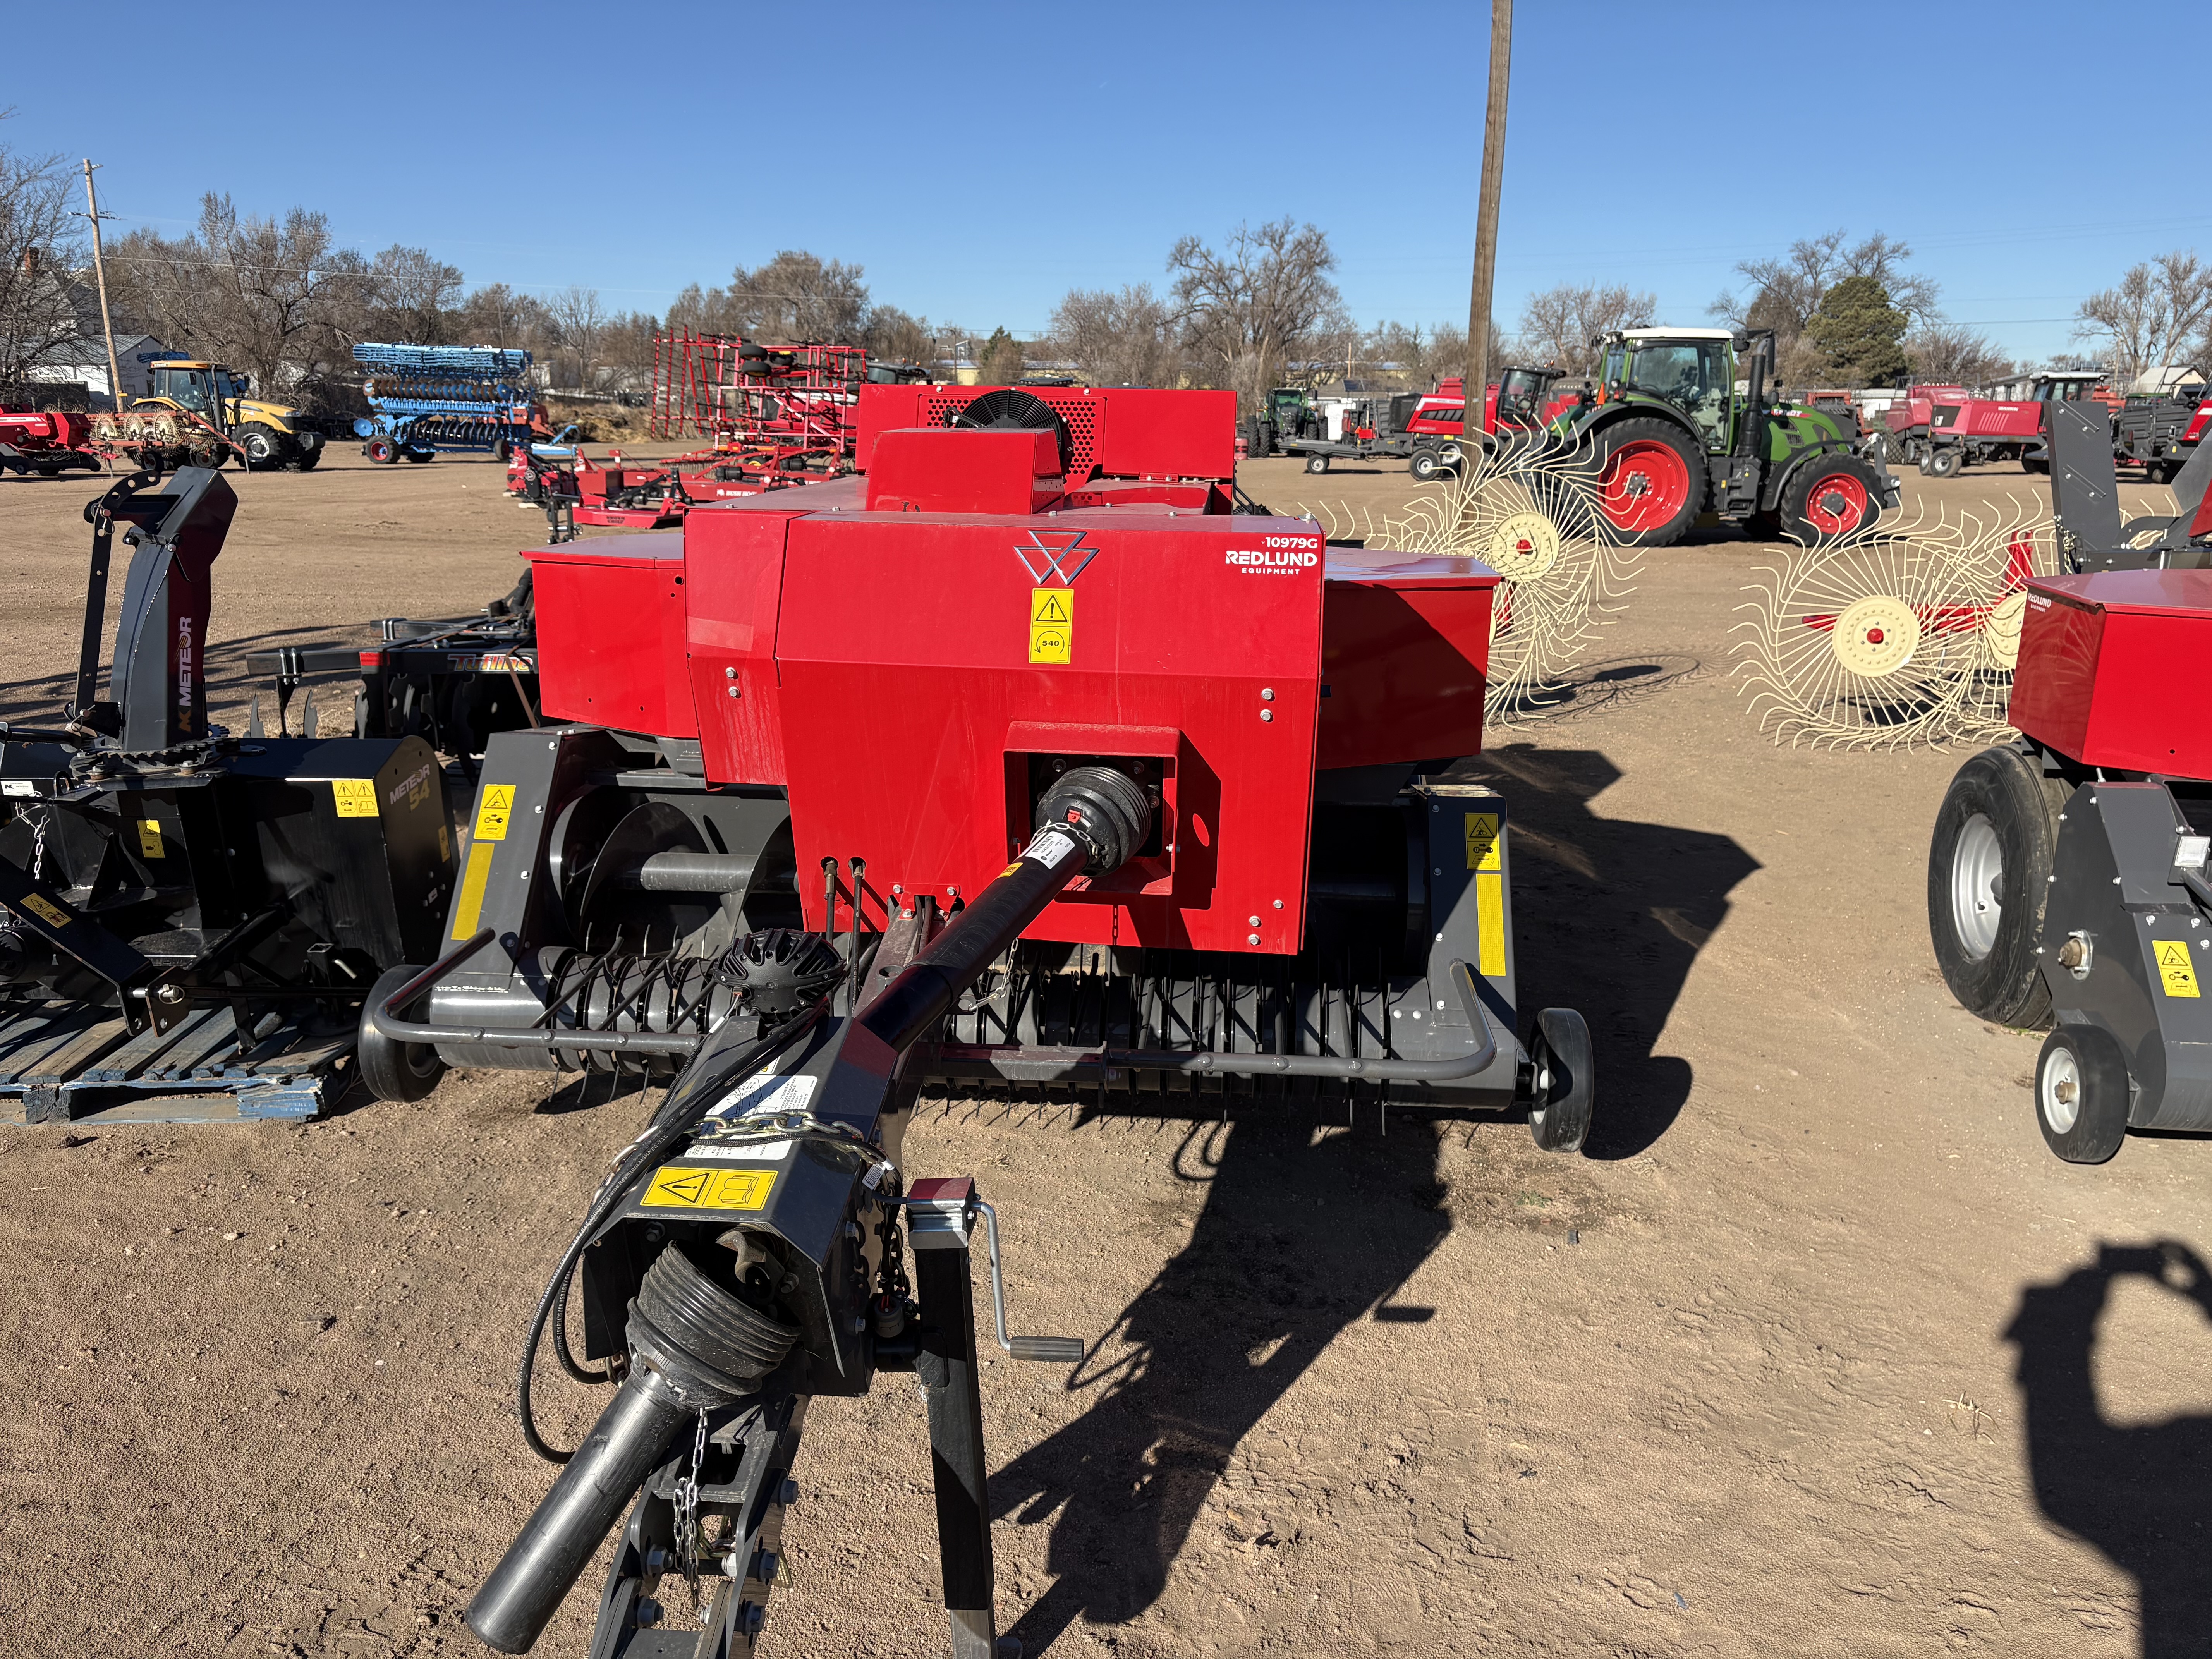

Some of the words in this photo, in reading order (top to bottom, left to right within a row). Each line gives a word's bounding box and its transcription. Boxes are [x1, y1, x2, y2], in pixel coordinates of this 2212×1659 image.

[1265, 537, 1317, 549] 10979G
[1225, 550, 1317, 567] REDLUND
[2028, 593, 2051, 608] REDLUND
[179, 617, 191, 707] METEOR
[448, 654, 533, 672] Tufline
[390, 764, 430, 804] METEOR
[409, 778, 430, 811] 54
